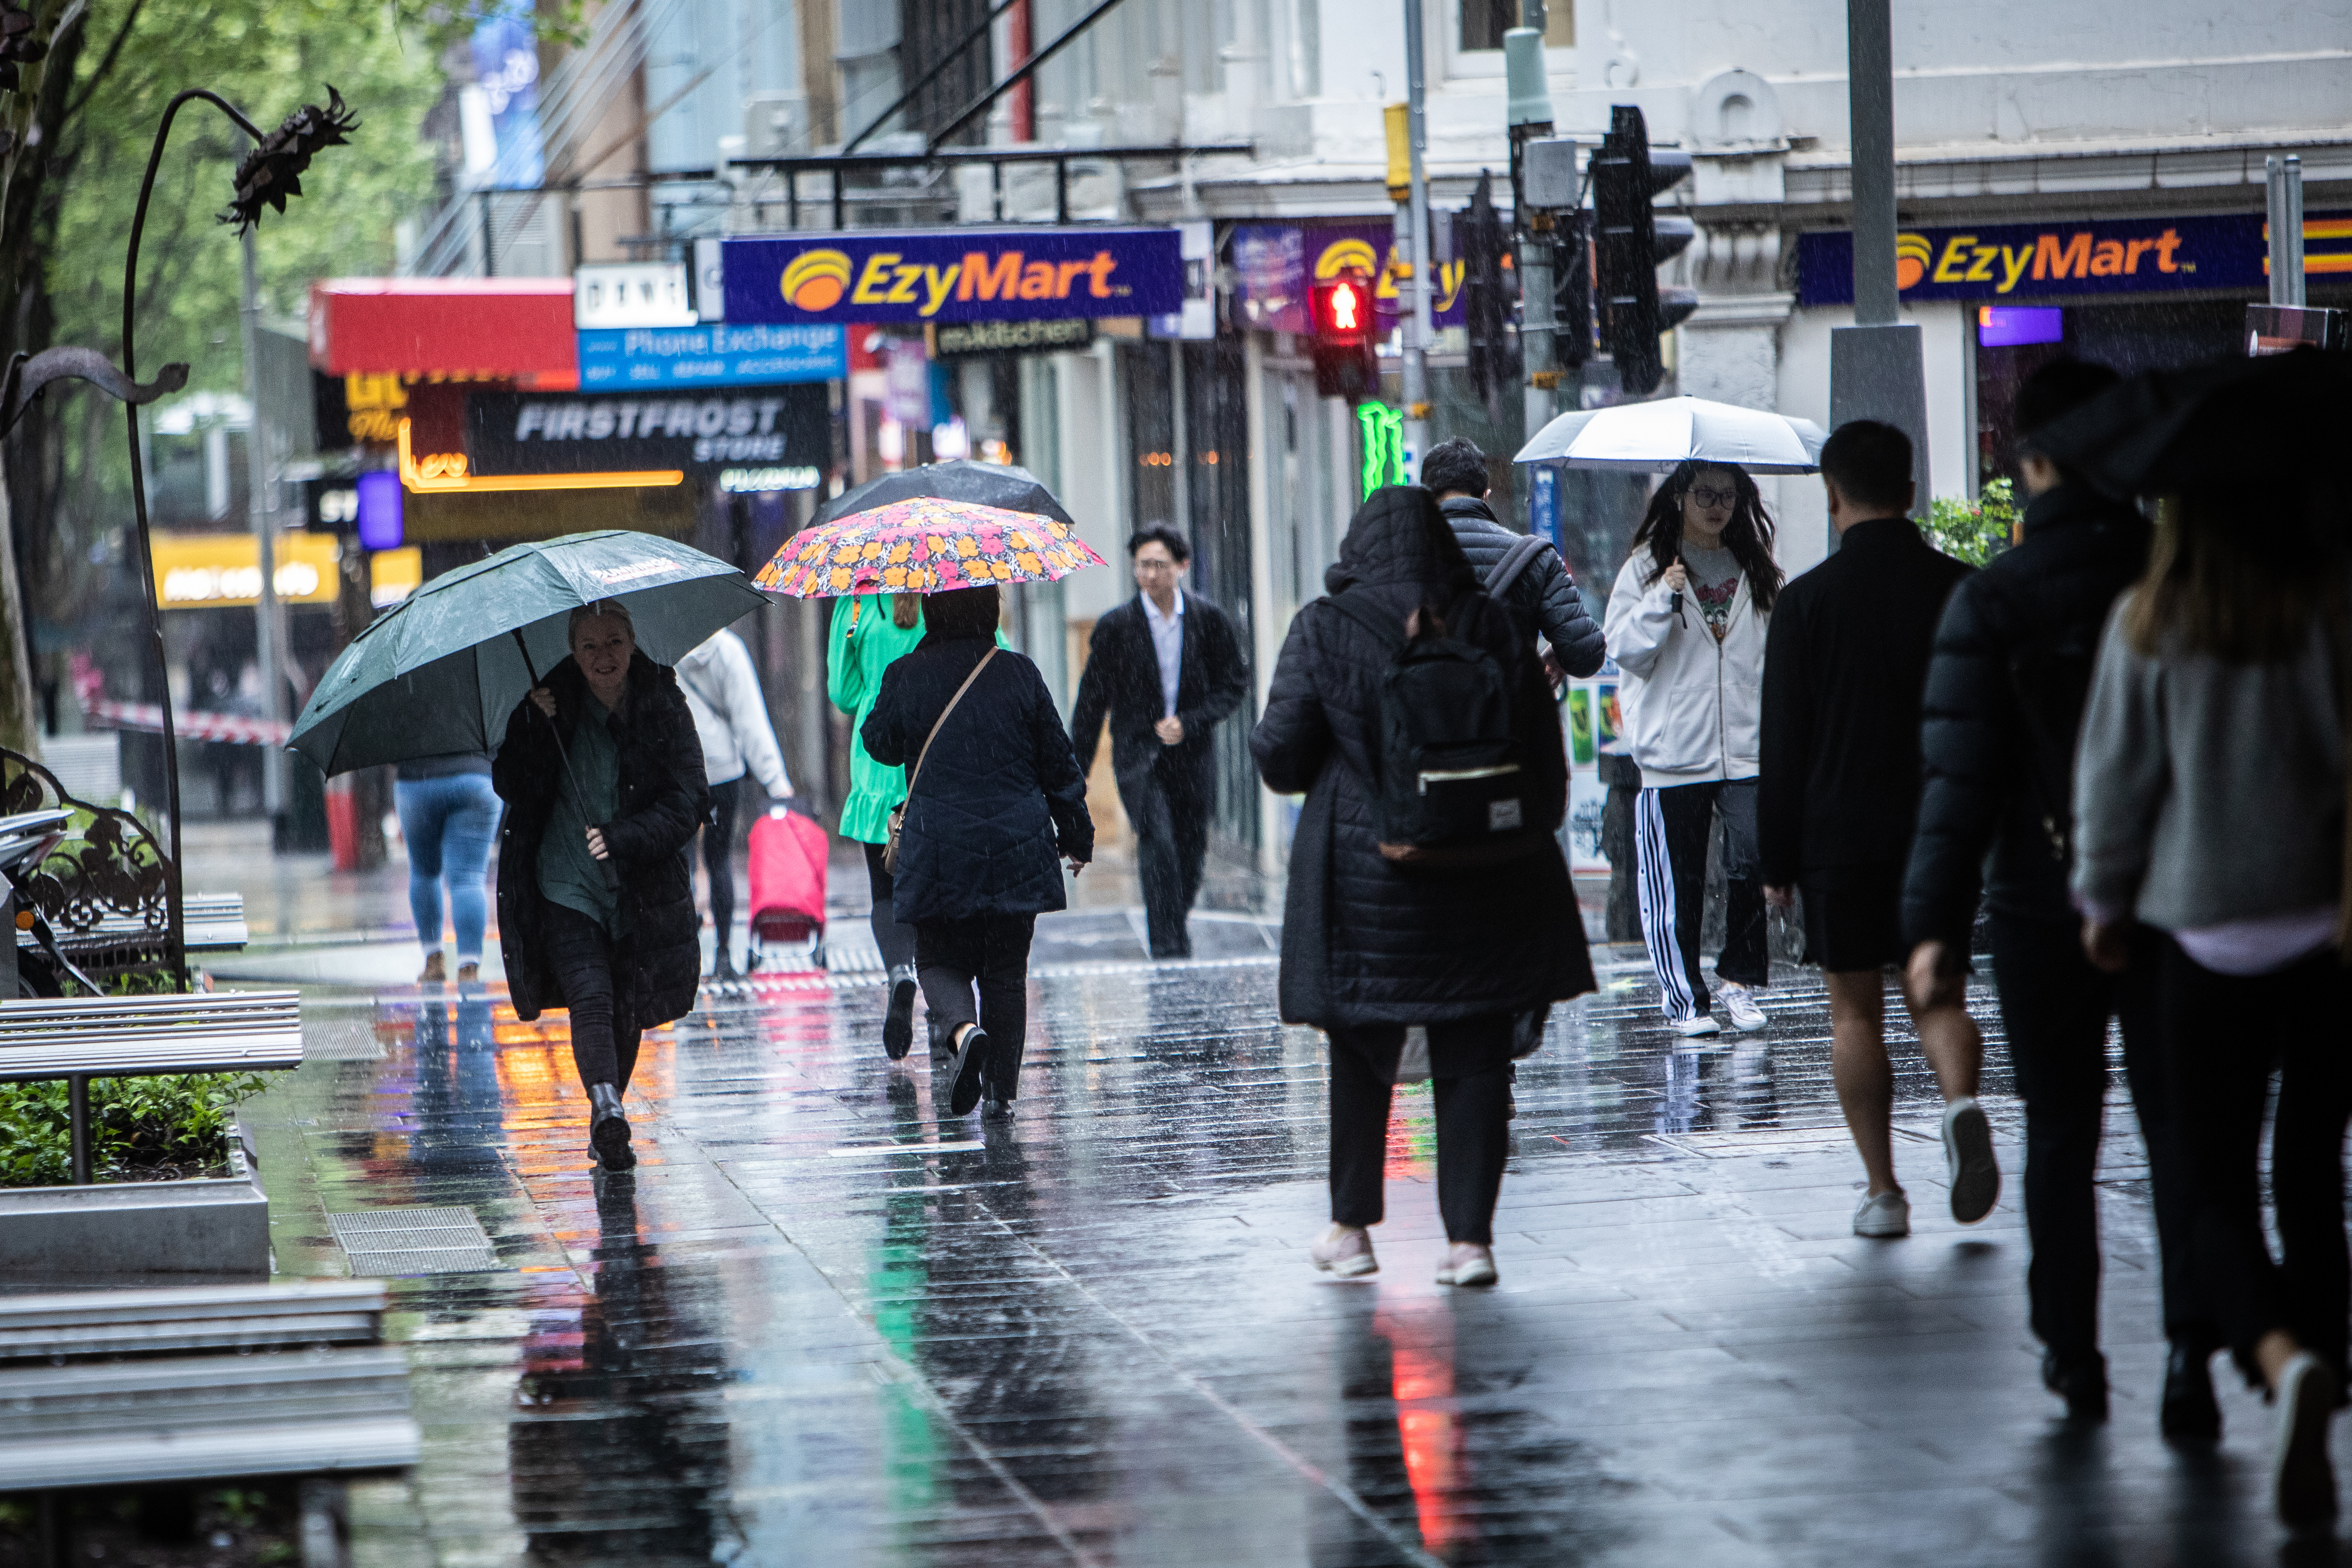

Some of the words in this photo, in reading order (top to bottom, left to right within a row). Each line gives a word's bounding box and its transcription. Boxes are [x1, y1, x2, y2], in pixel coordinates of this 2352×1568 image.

[1933, 228, 2182, 293] EzyMart
[851, 249, 1117, 316] EzyMart
[516, 399, 785, 441] FIRSTFROST
[694, 433, 785, 461] STORE
[589, 557, 673, 579] BUNNINGS
